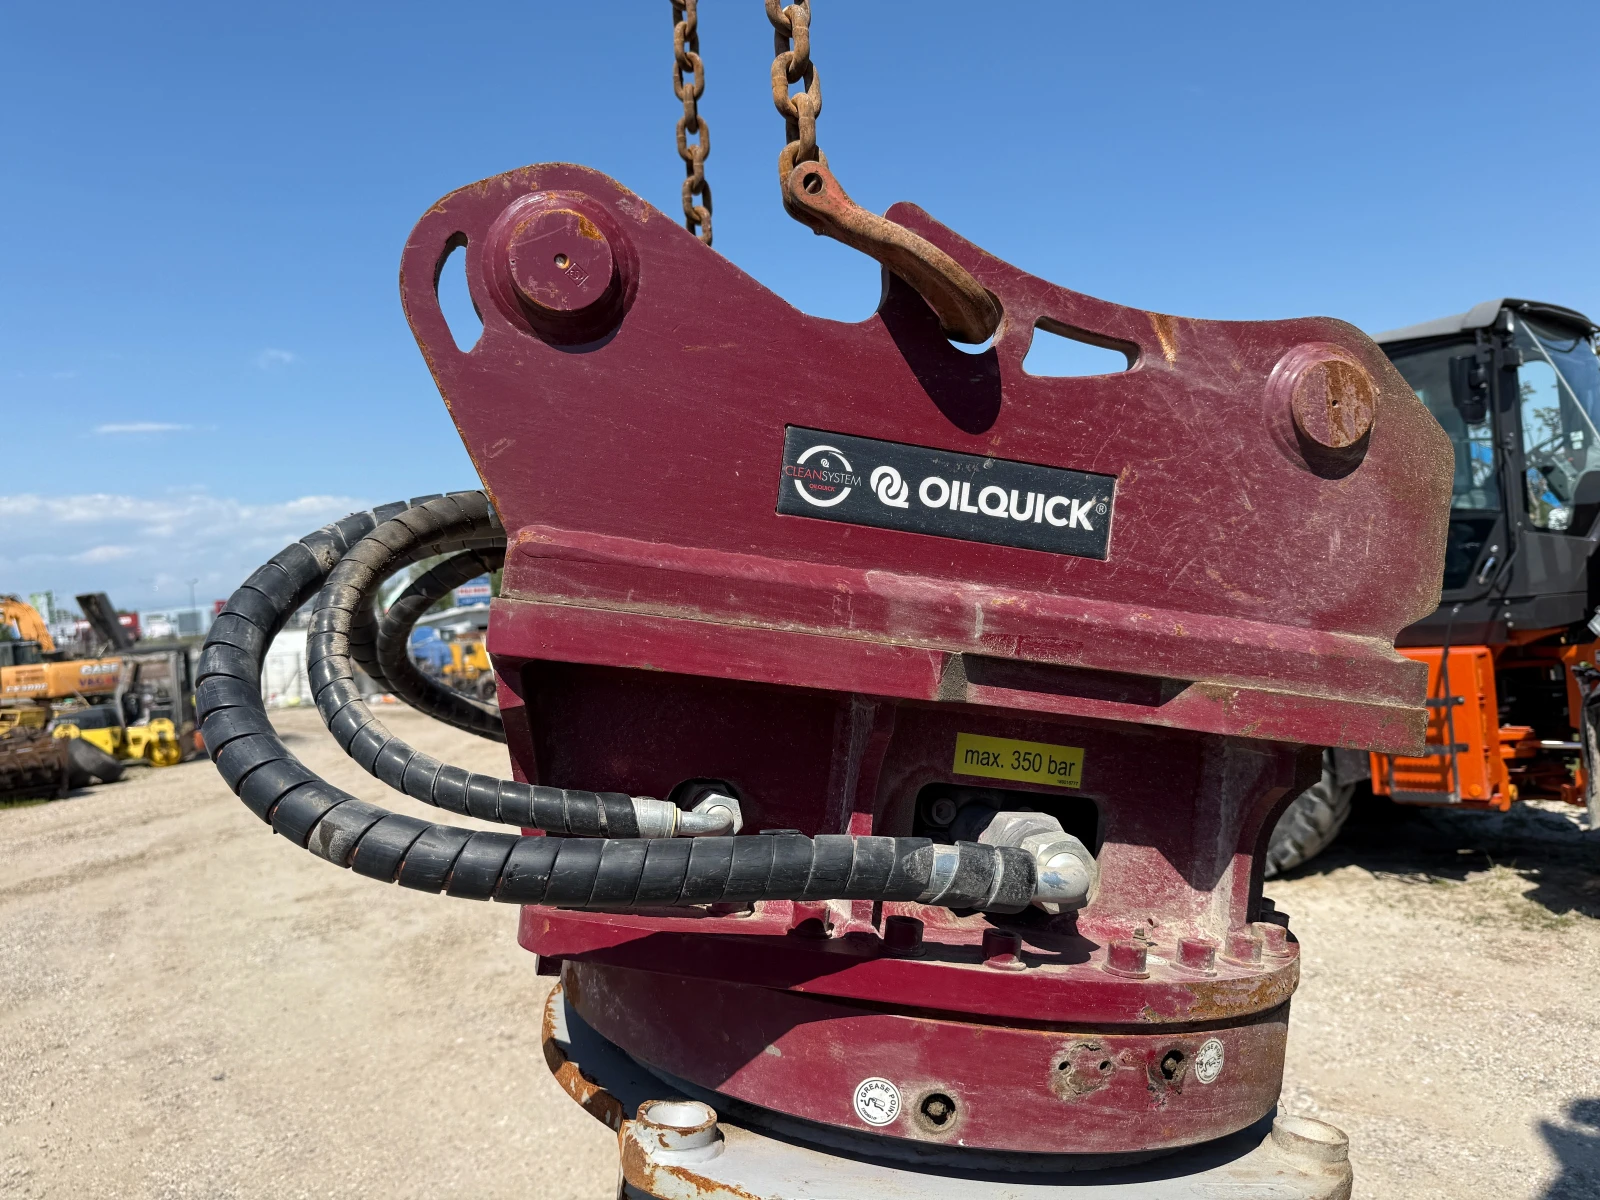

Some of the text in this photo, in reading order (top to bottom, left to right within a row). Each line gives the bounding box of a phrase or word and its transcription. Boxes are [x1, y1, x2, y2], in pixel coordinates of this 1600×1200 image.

[785, 465, 861, 486] CLEANSYSTEM
[964, 749, 1076, 776] max. 350 bar
[861, 1083, 891, 1098] GREASE
[885, 1094, 896, 1118] POINT
